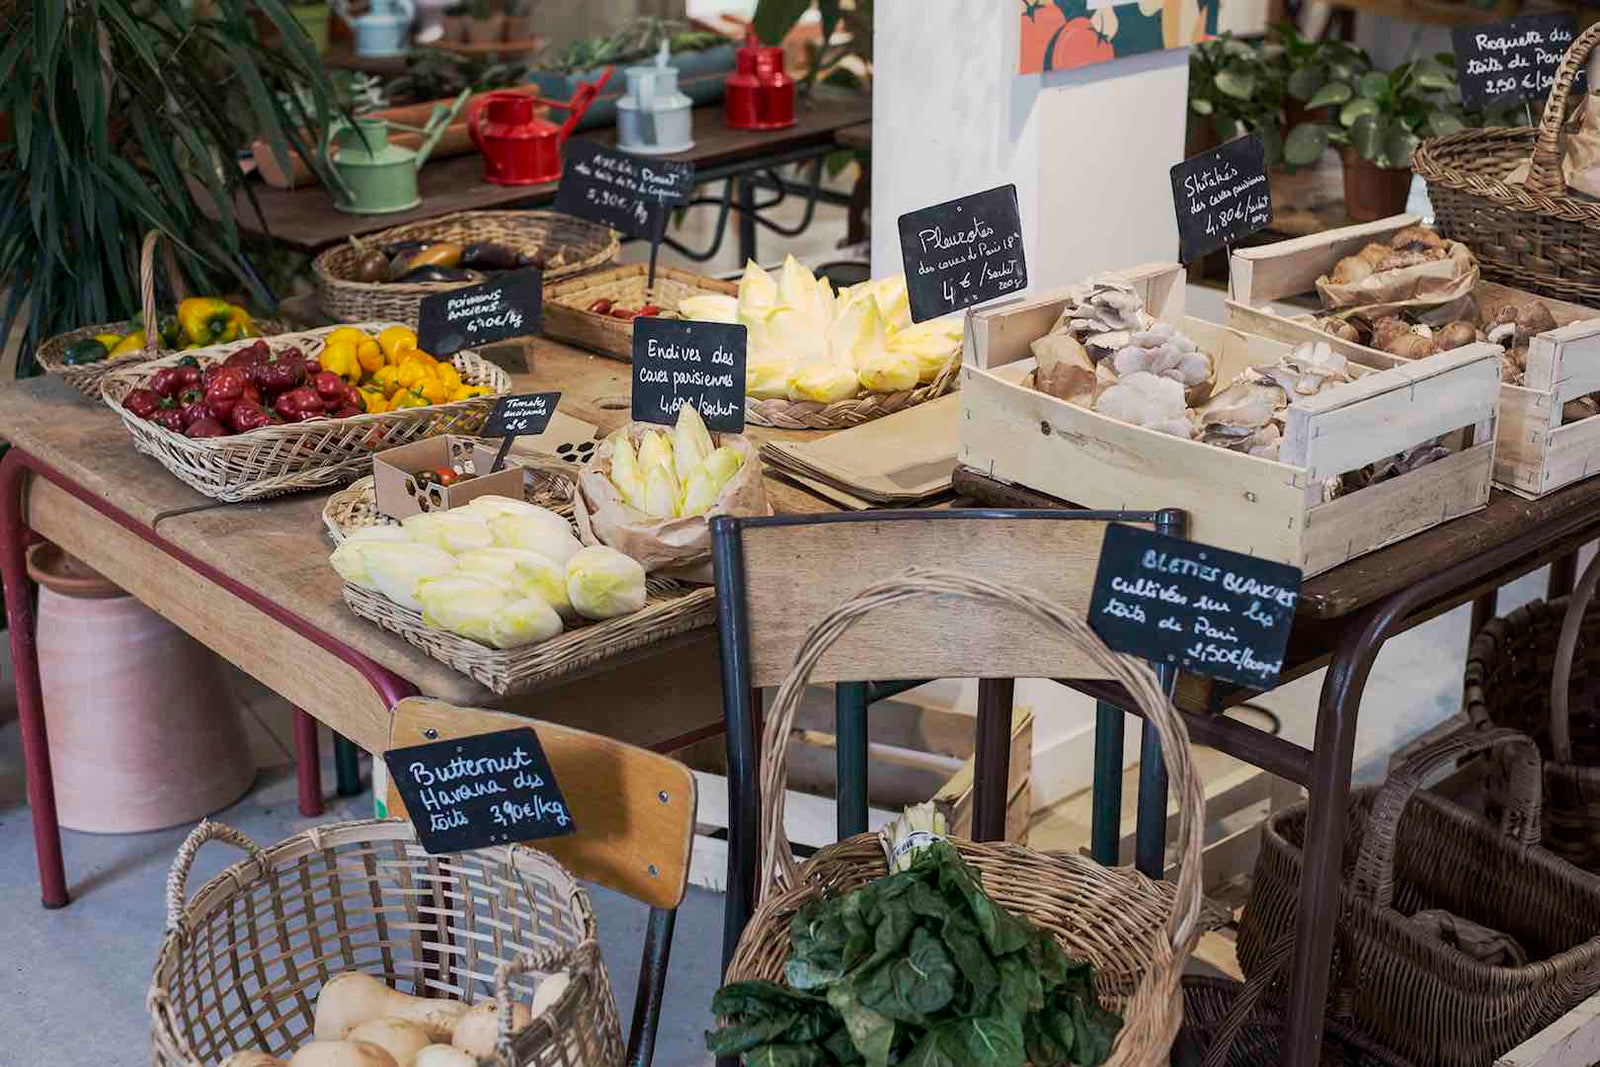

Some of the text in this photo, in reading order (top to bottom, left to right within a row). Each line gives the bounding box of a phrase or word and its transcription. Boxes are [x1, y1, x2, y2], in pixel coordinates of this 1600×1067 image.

[1467, 48, 1566, 75] toits de Pari
[1191, 197, 1206, 215] des
[918, 216, 994, 253] Pleurotes
[918, 260, 935, 275] des
[967, 248, 977, 260] de
[977, 240, 1001, 257] Paris
[943, 280, 955, 305] 4
[959, 272, 971, 288] €
[647, 338, 734, 366] Endives des
[673, 369, 734, 395] parisiennes
[1102, 598, 1239, 643] toits de Paris
[1192, 595, 1231, 612] sur
[1242, 600, 1274, 628] les
[408, 745, 532, 786] Butternut
[419, 770, 544, 812] Havana des
[430, 794, 571, 833] toits 3,90€/kg
